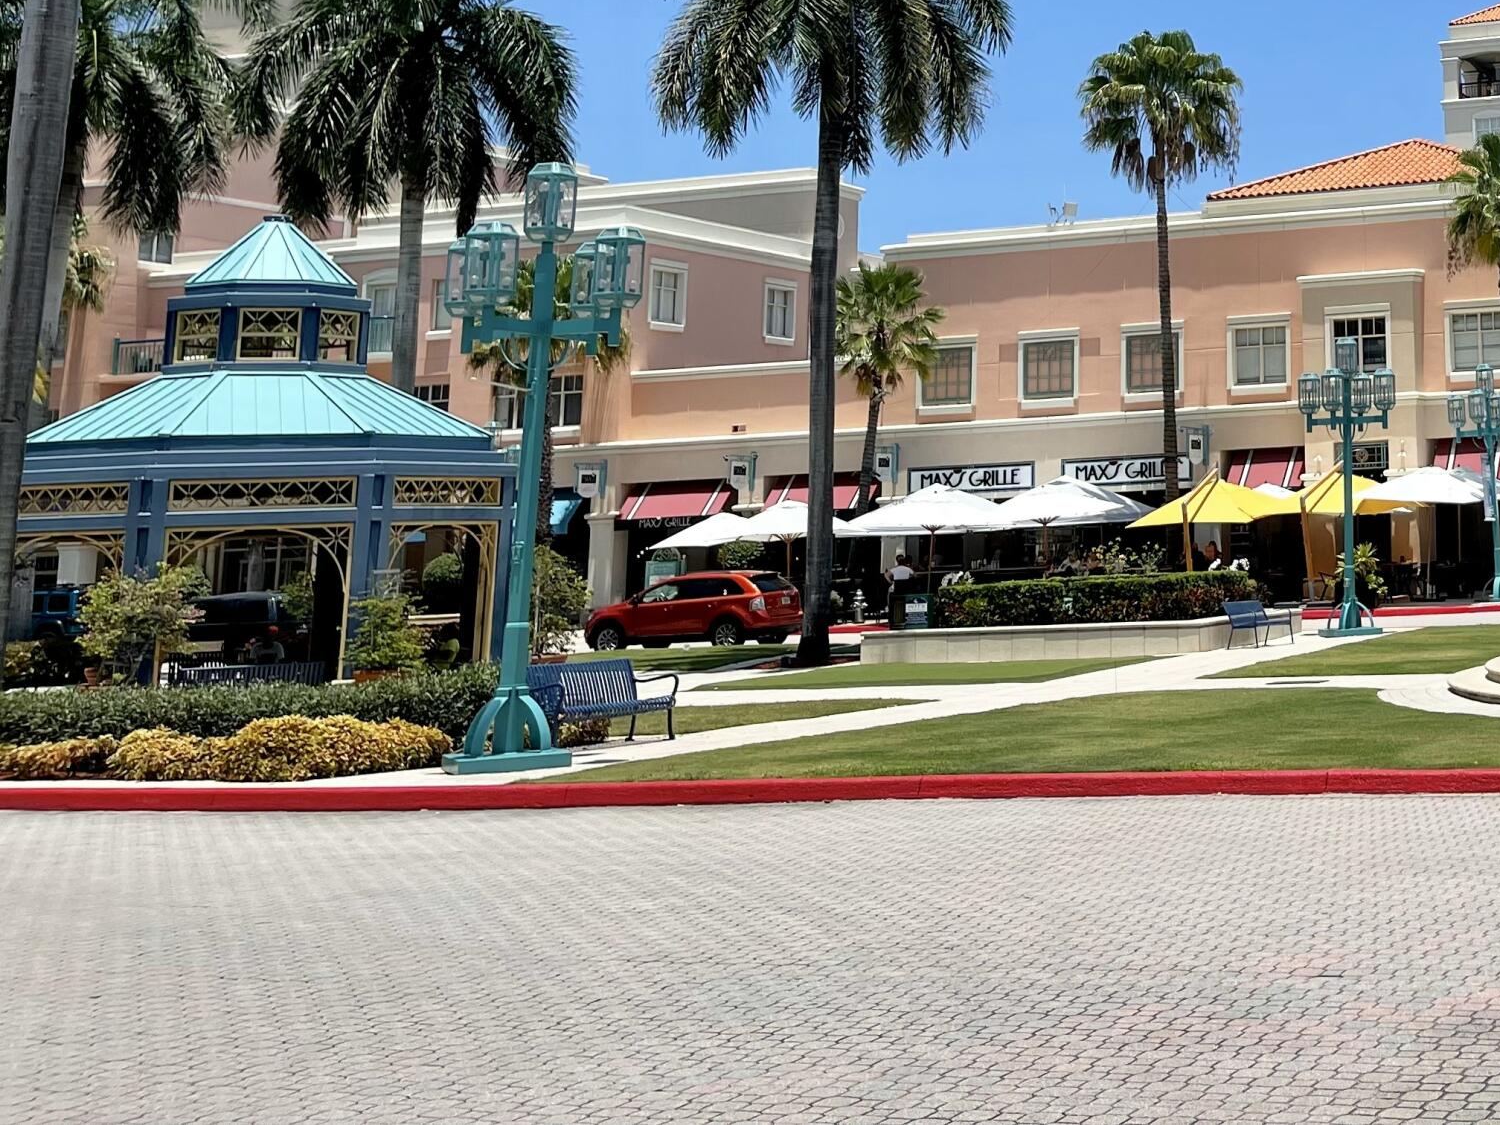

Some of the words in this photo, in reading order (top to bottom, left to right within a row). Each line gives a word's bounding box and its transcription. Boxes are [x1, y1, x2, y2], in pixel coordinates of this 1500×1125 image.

[968, 468, 1021, 487] GRILLE
[1124, 460, 1167, 479] GRILL
[664, 516, 692, 528] GRILLE
